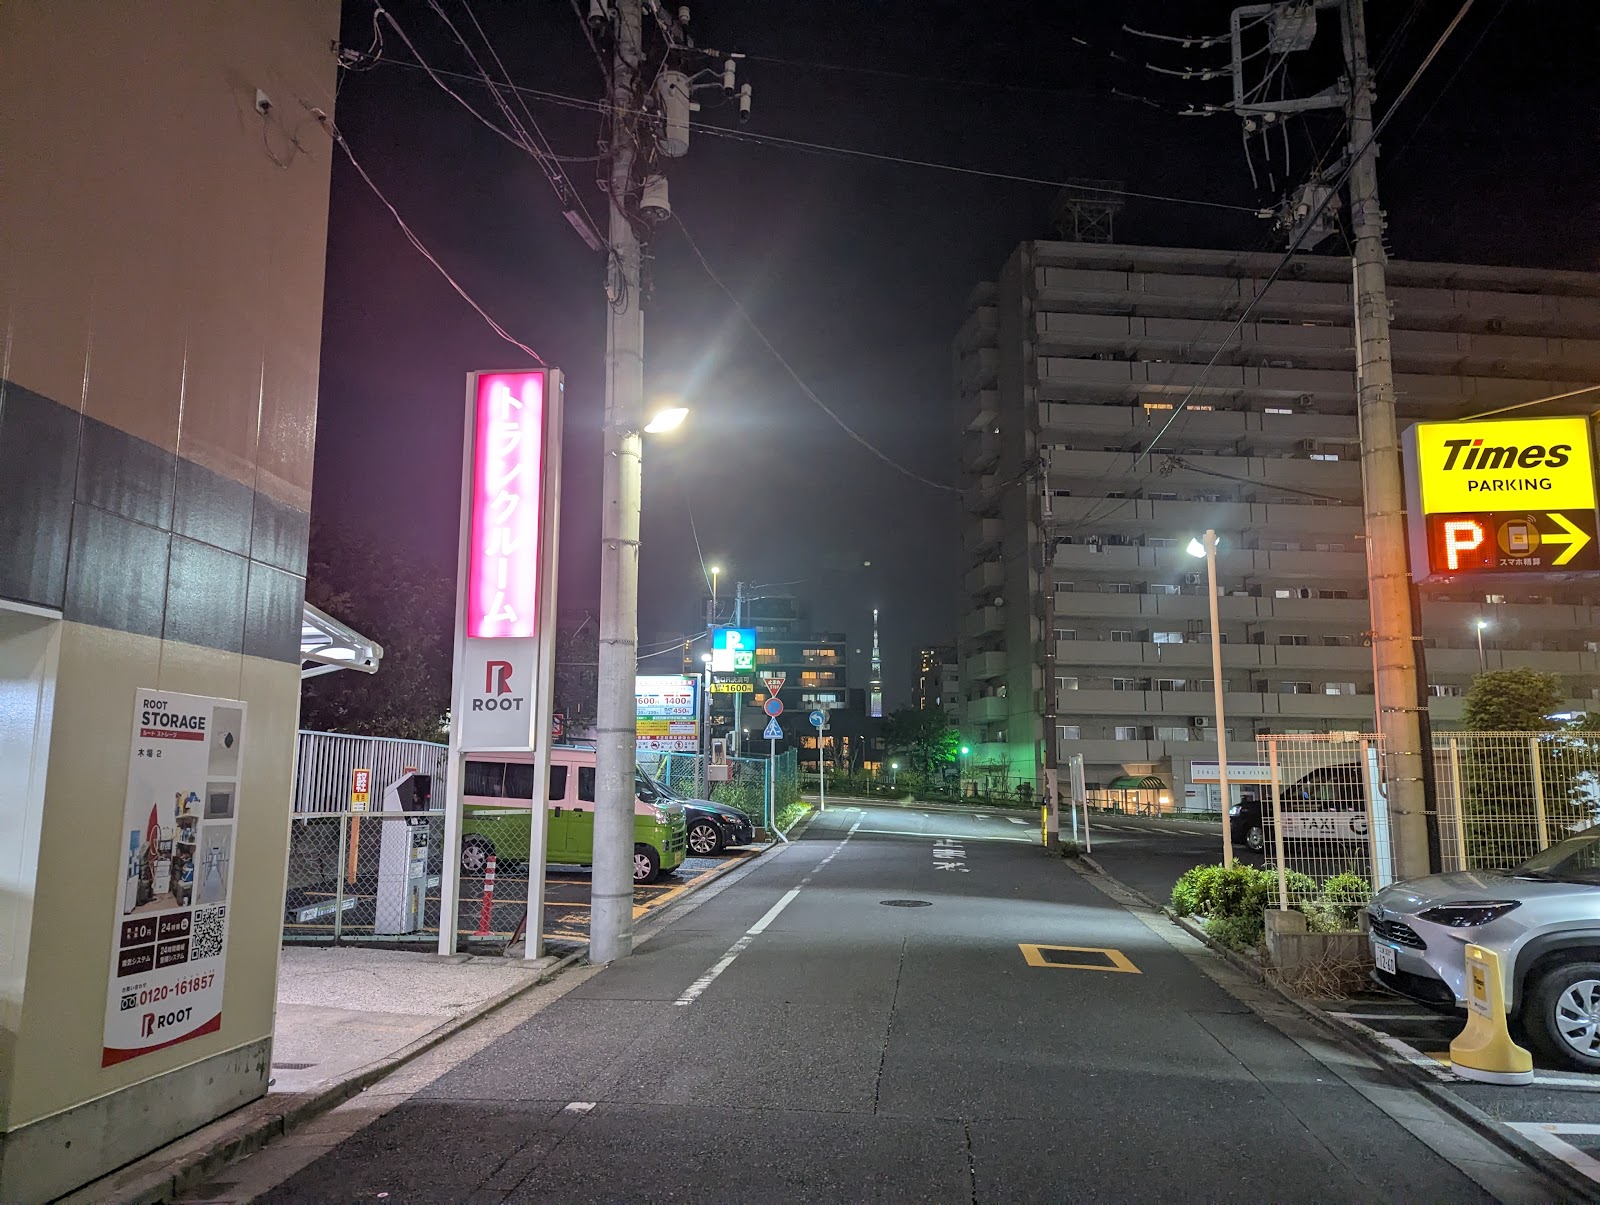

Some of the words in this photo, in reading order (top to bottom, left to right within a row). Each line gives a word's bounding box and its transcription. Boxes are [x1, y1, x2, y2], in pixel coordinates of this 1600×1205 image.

[1443, 439, 1572, 471] Times
[1468, 478, 1552, 492] PARKING
[482, 386, 523, 624] トランクルーム
[1444, 521, 1484, 570] P
[143, 699, 168, 710] ROOT
[472, 697, 524, 712] ROOT
[141, 710, 206, 731] STORAGE
[1300, 818, 1335, 830] TAXI
[140, 974, 215, 1006] 0120-161857
[157, 1007, 193, 1029] ROOT
